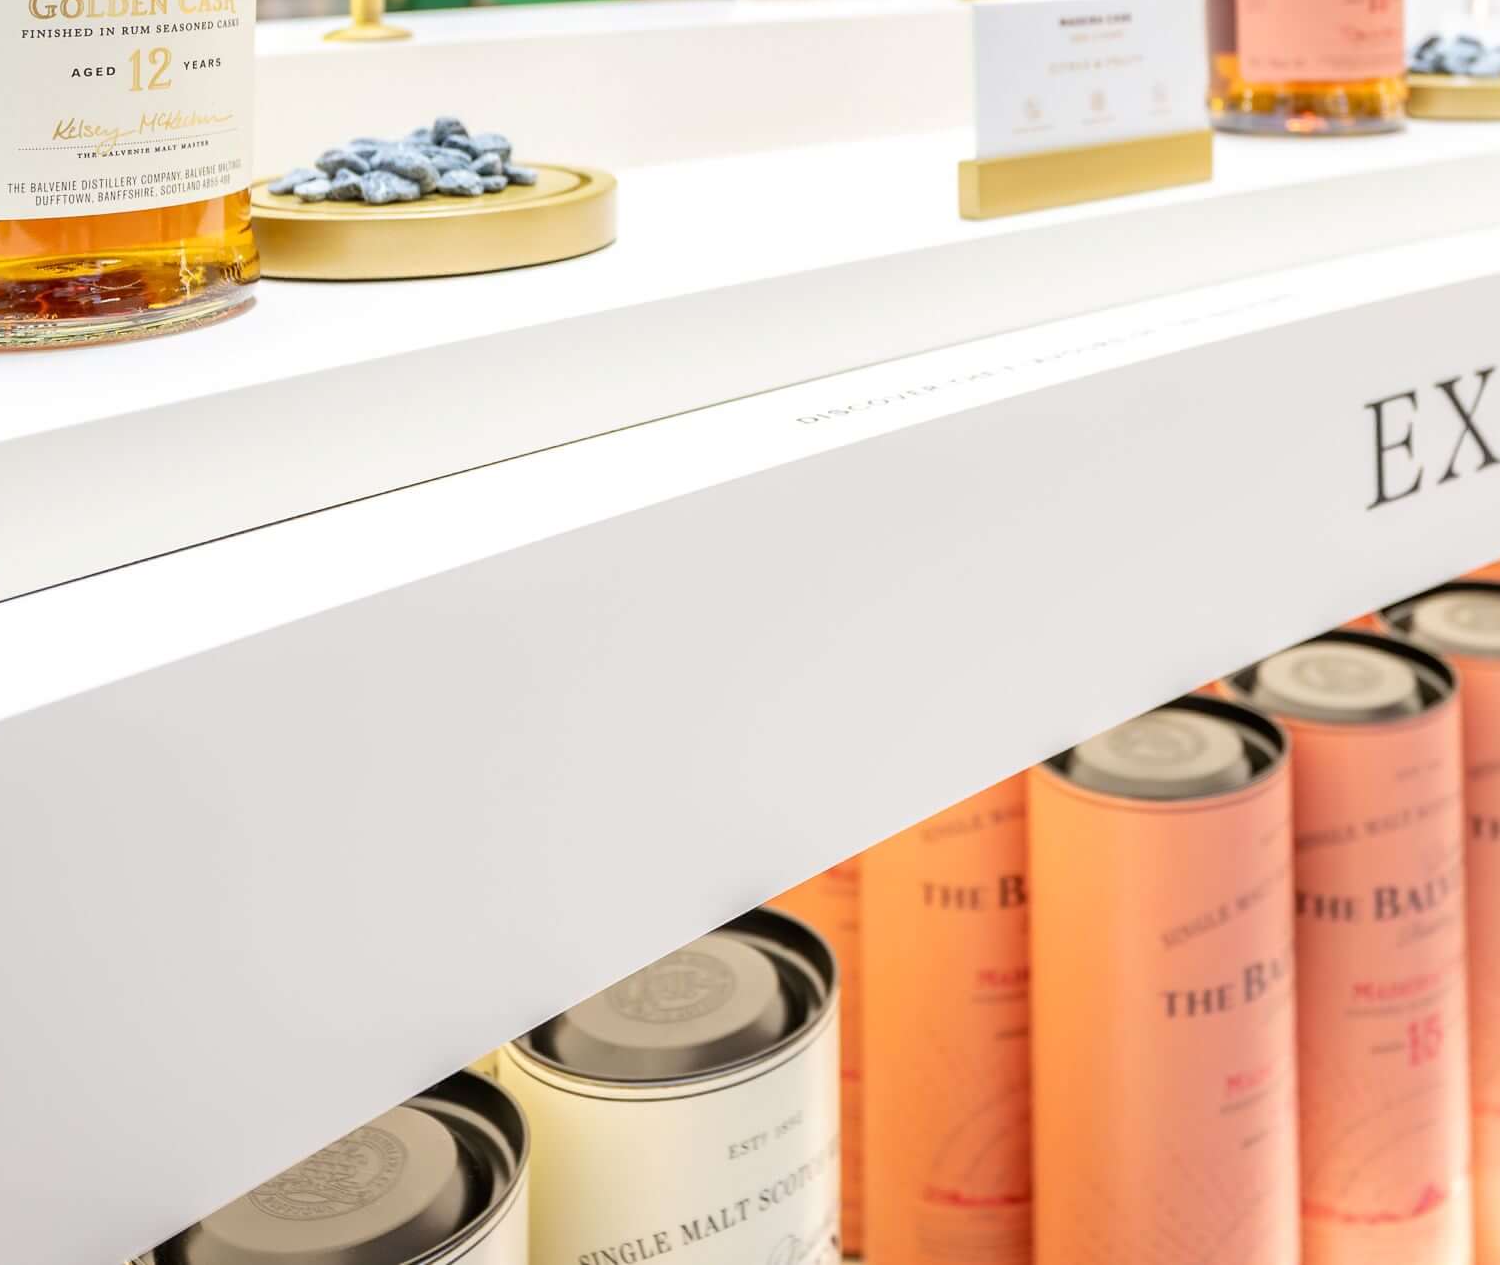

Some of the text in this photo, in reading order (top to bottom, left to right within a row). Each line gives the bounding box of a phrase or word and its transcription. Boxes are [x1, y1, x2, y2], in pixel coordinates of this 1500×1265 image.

[21, 26, 94, 39] FINISHED
[99, 25, 116, 37] IN
[122, 24, 151, 36] RUM
[156, 20, 215, 34] SEASONED
[71, 46, 222, 92] AGED 12 YEARS
[77, 151, 98, 160] THE
[154, 143, 177, 154] MALT
[7, 181, 26, 194] THE
[30, 179, 77, 193] BALVENIE
[81, 174, 138, 191] DISTILLERY
[184, 164, 218, 181] BALVENIE
[160, 179, 201, 197] SCOTLAND
[922, 882, 988, 911] THE
[1160, 982, 1238, 1019] THE
[681, 1197, 752, 1246] MALT
